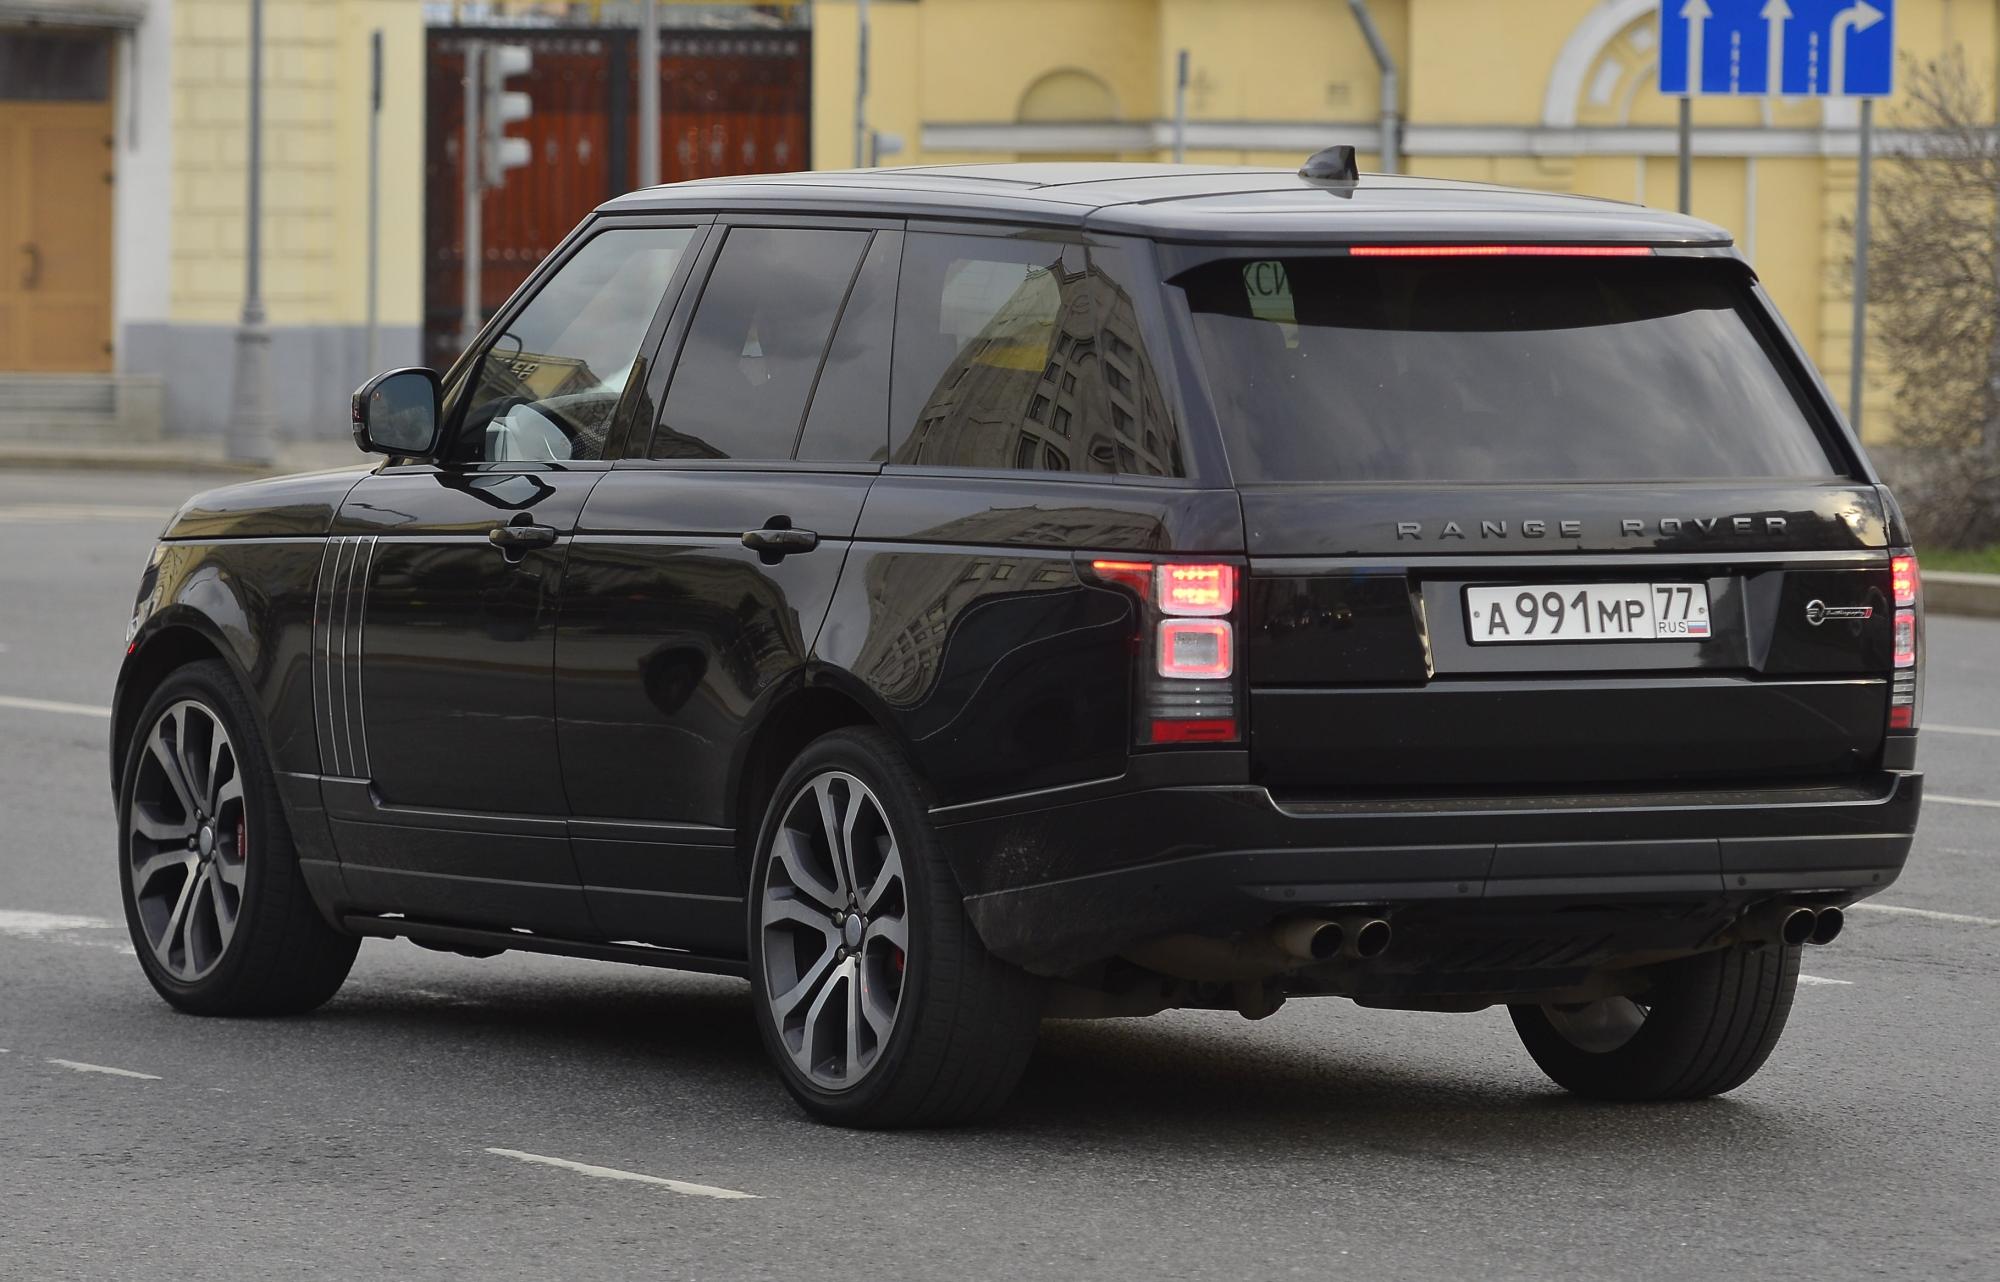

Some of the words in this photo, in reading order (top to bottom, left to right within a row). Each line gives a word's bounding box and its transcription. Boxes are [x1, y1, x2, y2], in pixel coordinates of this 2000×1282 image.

[1397, 520, 1582, 540] RANGE
[1621, 517, 1788, 537] ROVER
[1656, 587, 1693, 620] 77
[1658, 621, 1687, 634] RUS
